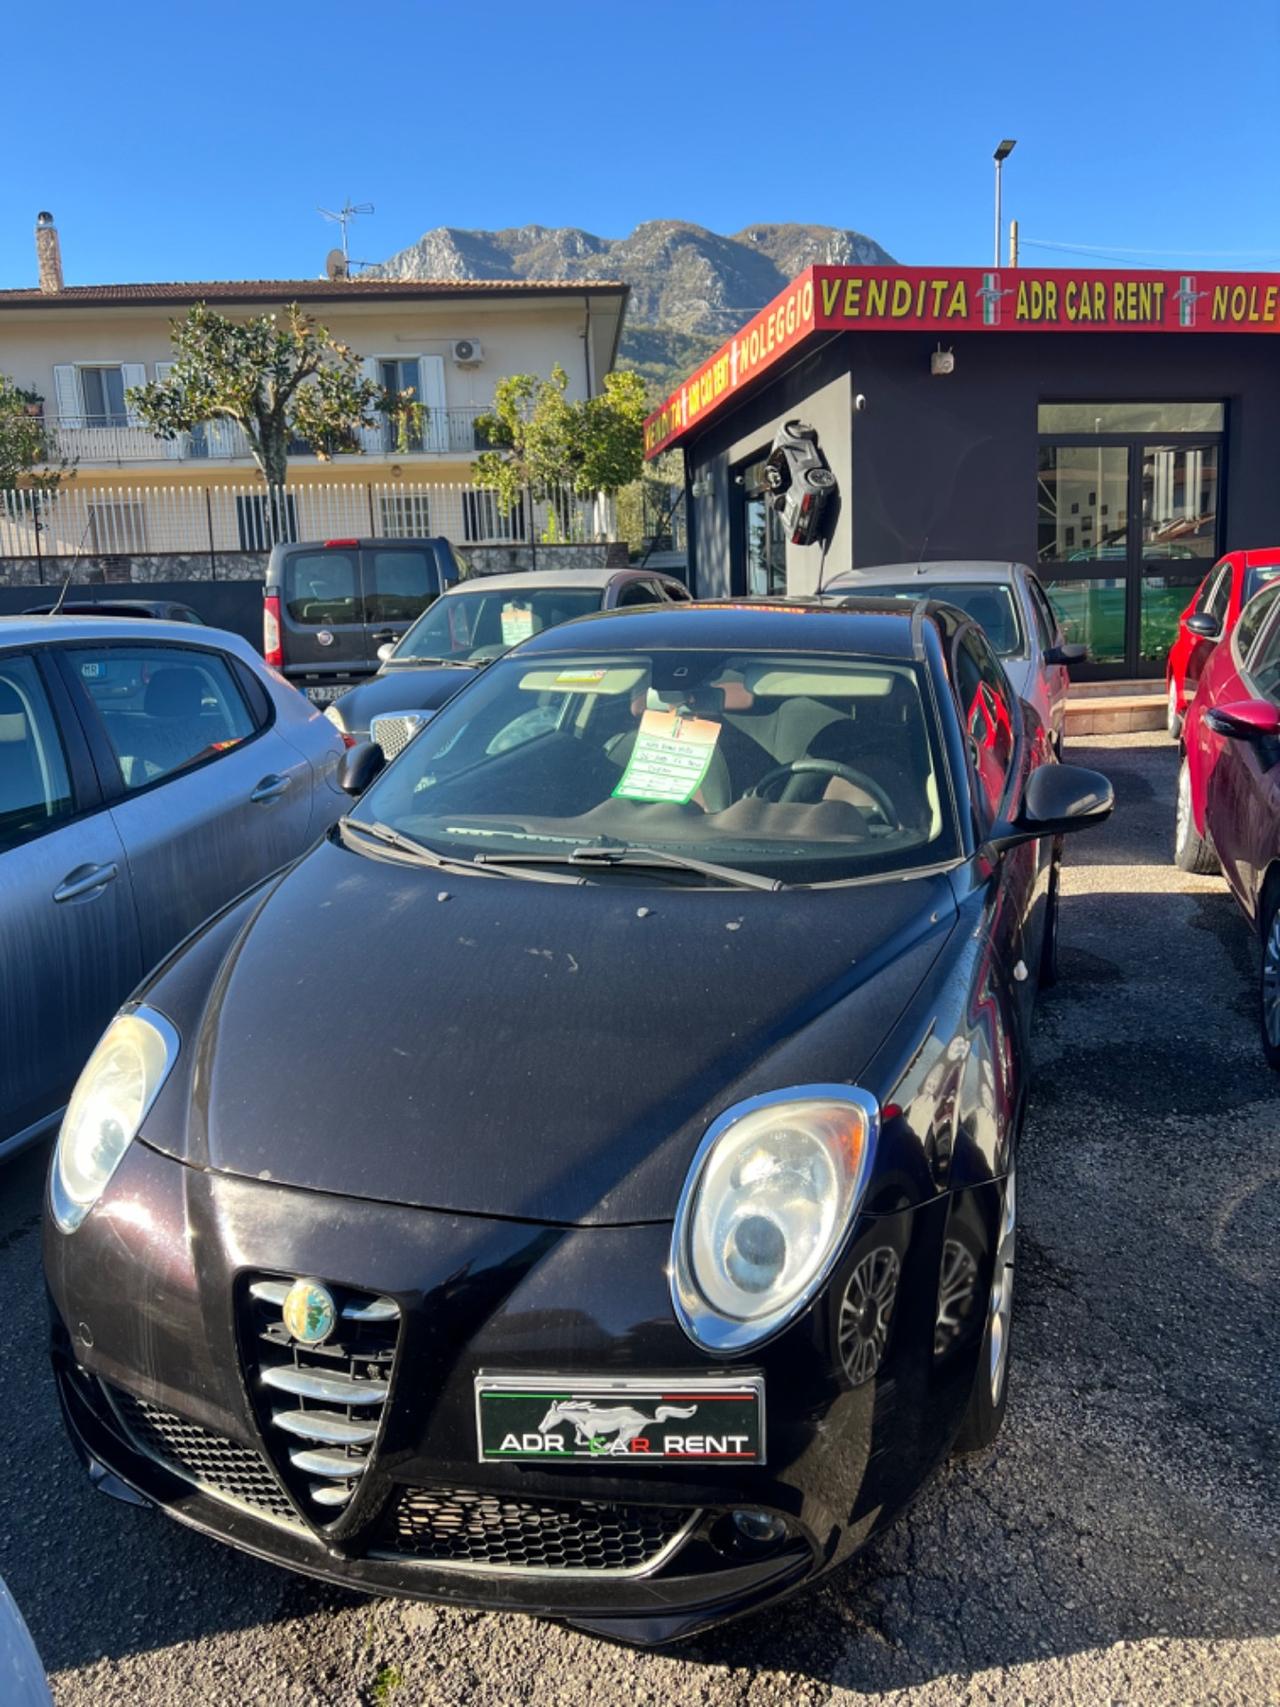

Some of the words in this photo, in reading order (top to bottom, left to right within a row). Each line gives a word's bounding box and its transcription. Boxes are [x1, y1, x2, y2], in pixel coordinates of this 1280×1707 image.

[820, 278, 968, 318] VENDITA
[1016, 280, 1058, 321] ADR
[1065, 280, 1106, 321] CAR
[1113, 281, 1165, 321] RENT
[740, 280, 814, 373] NOLEGGIO
[499, 1433, 565, 1452] ADR
[588, 1436, 651, 1455] CAR
[664, 1435, 749, 1454] RENT
